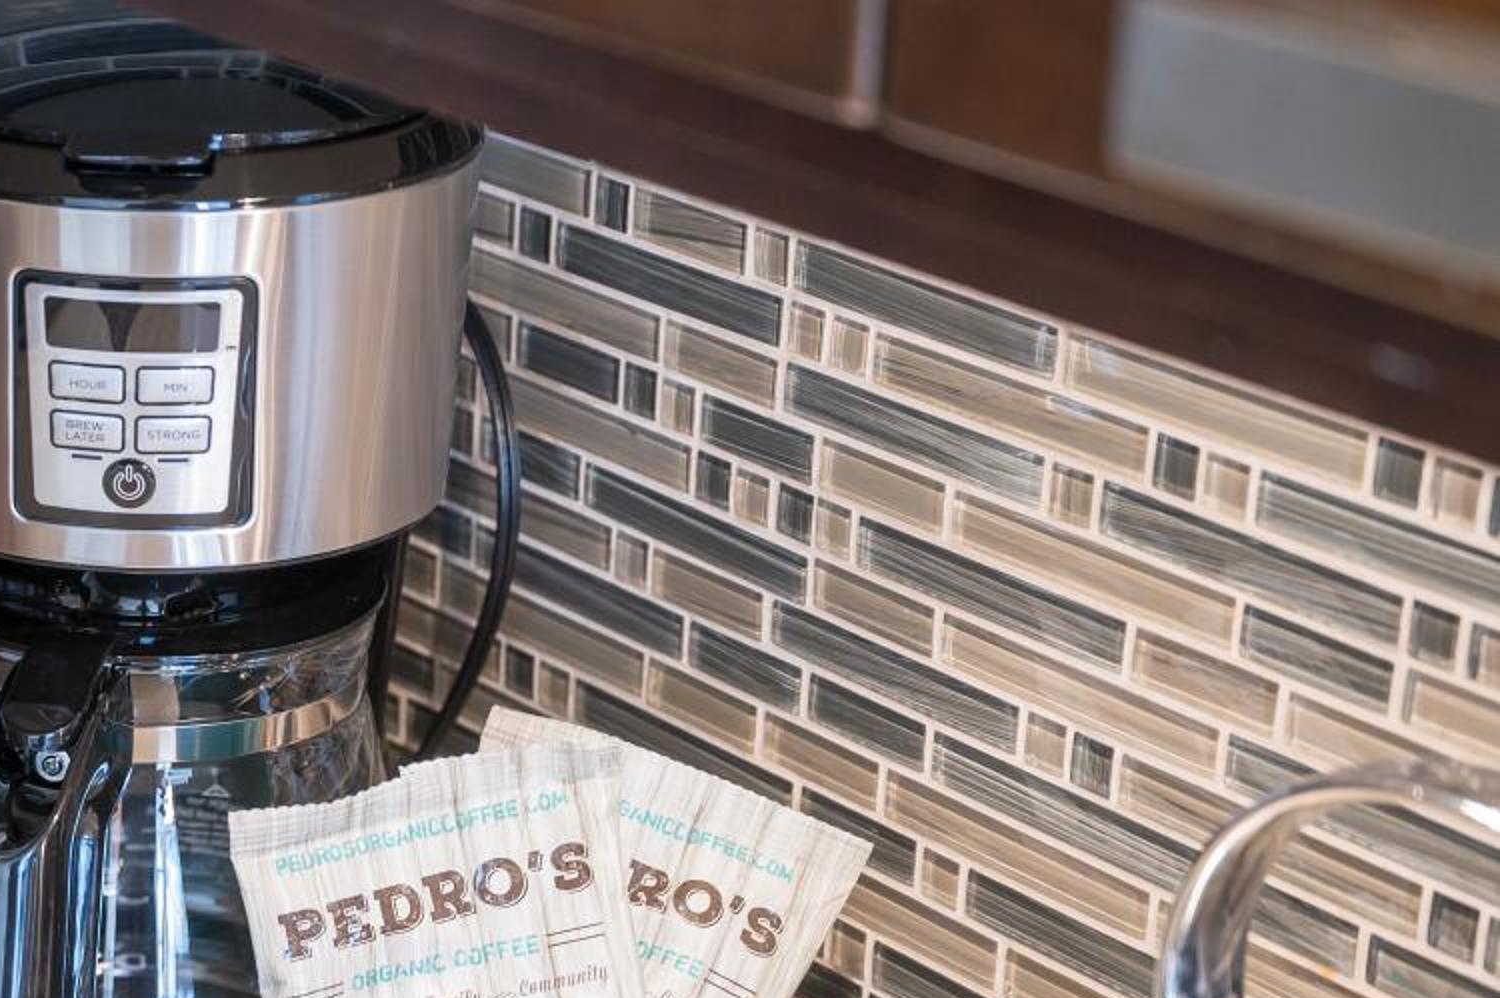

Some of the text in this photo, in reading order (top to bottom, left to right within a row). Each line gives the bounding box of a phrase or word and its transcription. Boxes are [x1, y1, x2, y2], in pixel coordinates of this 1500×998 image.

[69, 377, 106, 390] HOUR
[163, 383, 189, 393] MIN
[65, 419, 104, 431] BREW
[65, 431, 105, 443] LATER
[147, 430, 202, 441] STRONG
[277, 842, 594, 963] PEDRO'S
[627, 859, 785, 958] RO'S
[352, 934, 541, 991] ORGANIC COFFEE
[518, 963, 610, 998] Community
